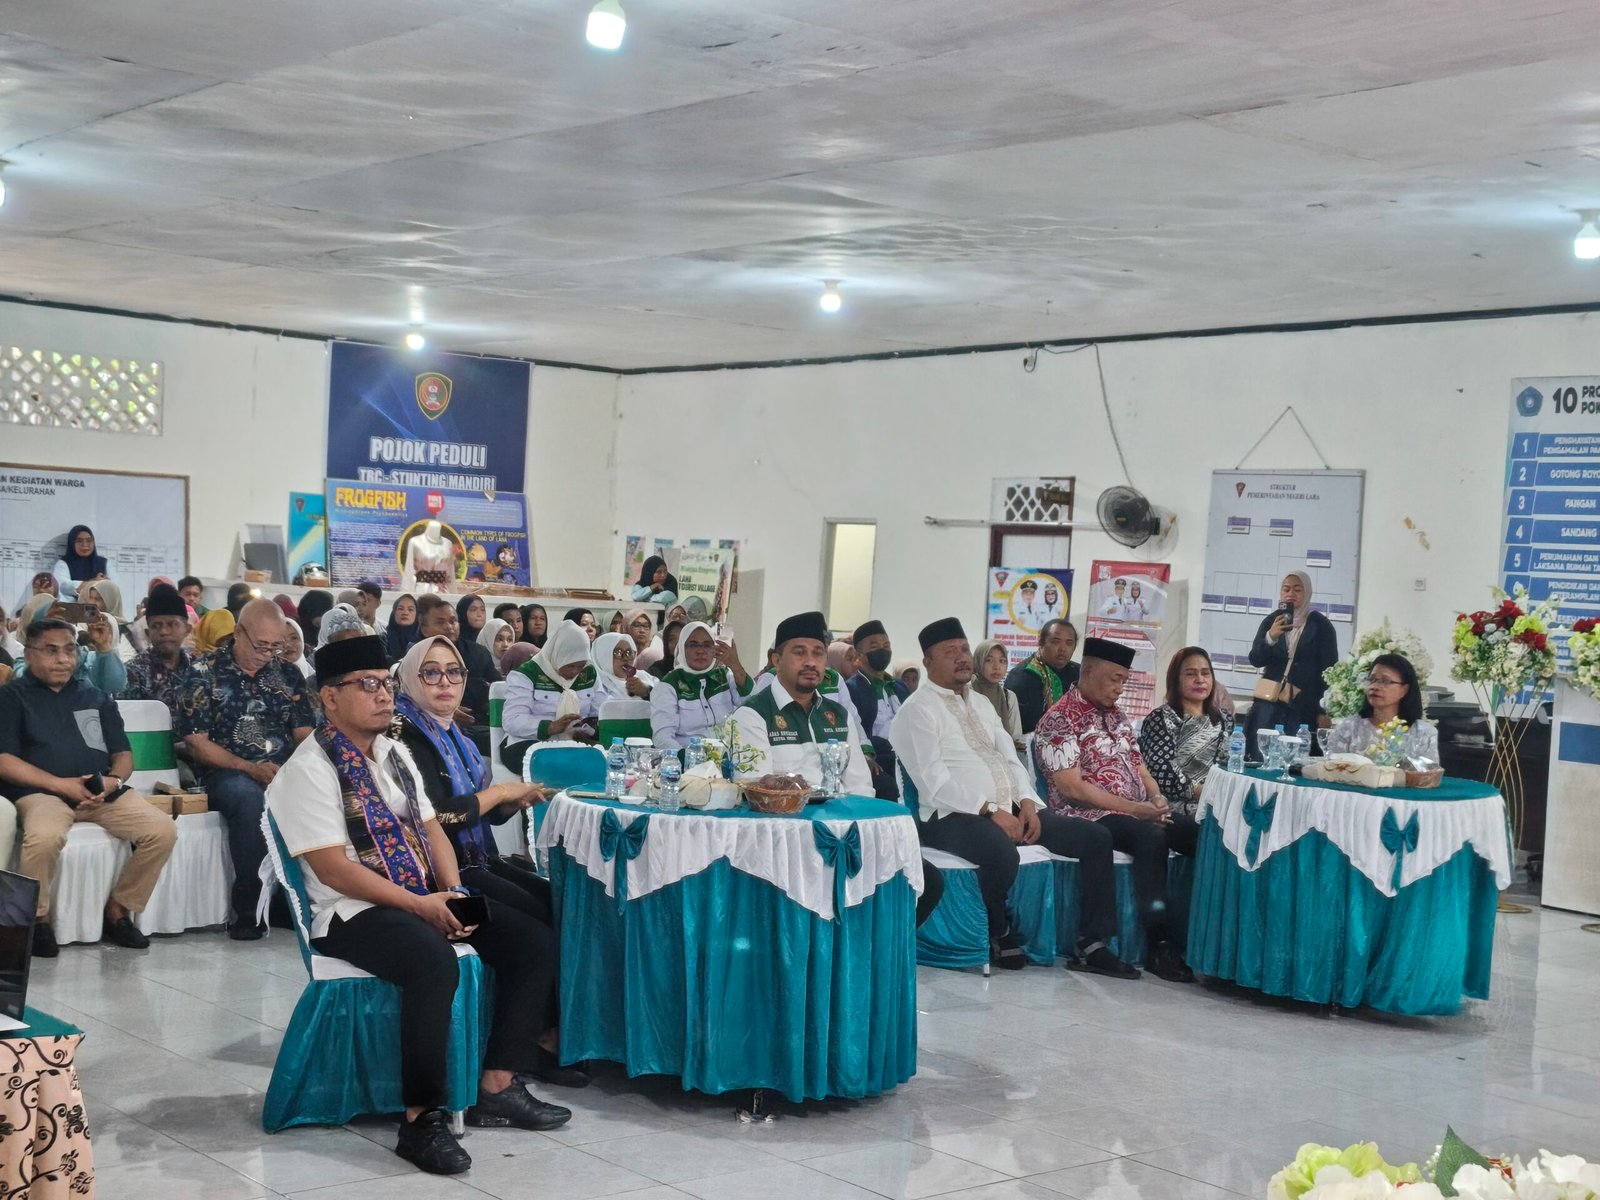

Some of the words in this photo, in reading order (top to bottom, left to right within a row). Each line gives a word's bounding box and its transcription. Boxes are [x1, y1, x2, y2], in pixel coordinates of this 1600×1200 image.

[1553, 387, 1578, 414] 10
[369, 436, 427, 464] POJOK
[428, 441, 487, 468] PEDULI
[1522, 438, 1528, 453] 1
[9, 475, 53, 486] KEGIATAN
[54, 478, 85, 488] WARGA
[390, 469, 447, 487] STUNTING
[448, 474, 496, 491] MANDIRI
[1519, 467, 1526, 481] 2
[1550, 470, 1580, 479] GOTONG
[335, 487, 407, 511] FROGFISH
[1518, 495, 1525, 510] 3
[1565, 499, 1597, 508] PANGAN
[1516, 524, 1523, 539] 4
[1561, 527, 1597, 537] SANDANG
[1514, 553, 1521, 568] 5
[1540, 553, 1582, 561] PERUMAHAN
[679, 583, 697, 591] TOURIST
[698, 584, 715, 592] VILLAGE
